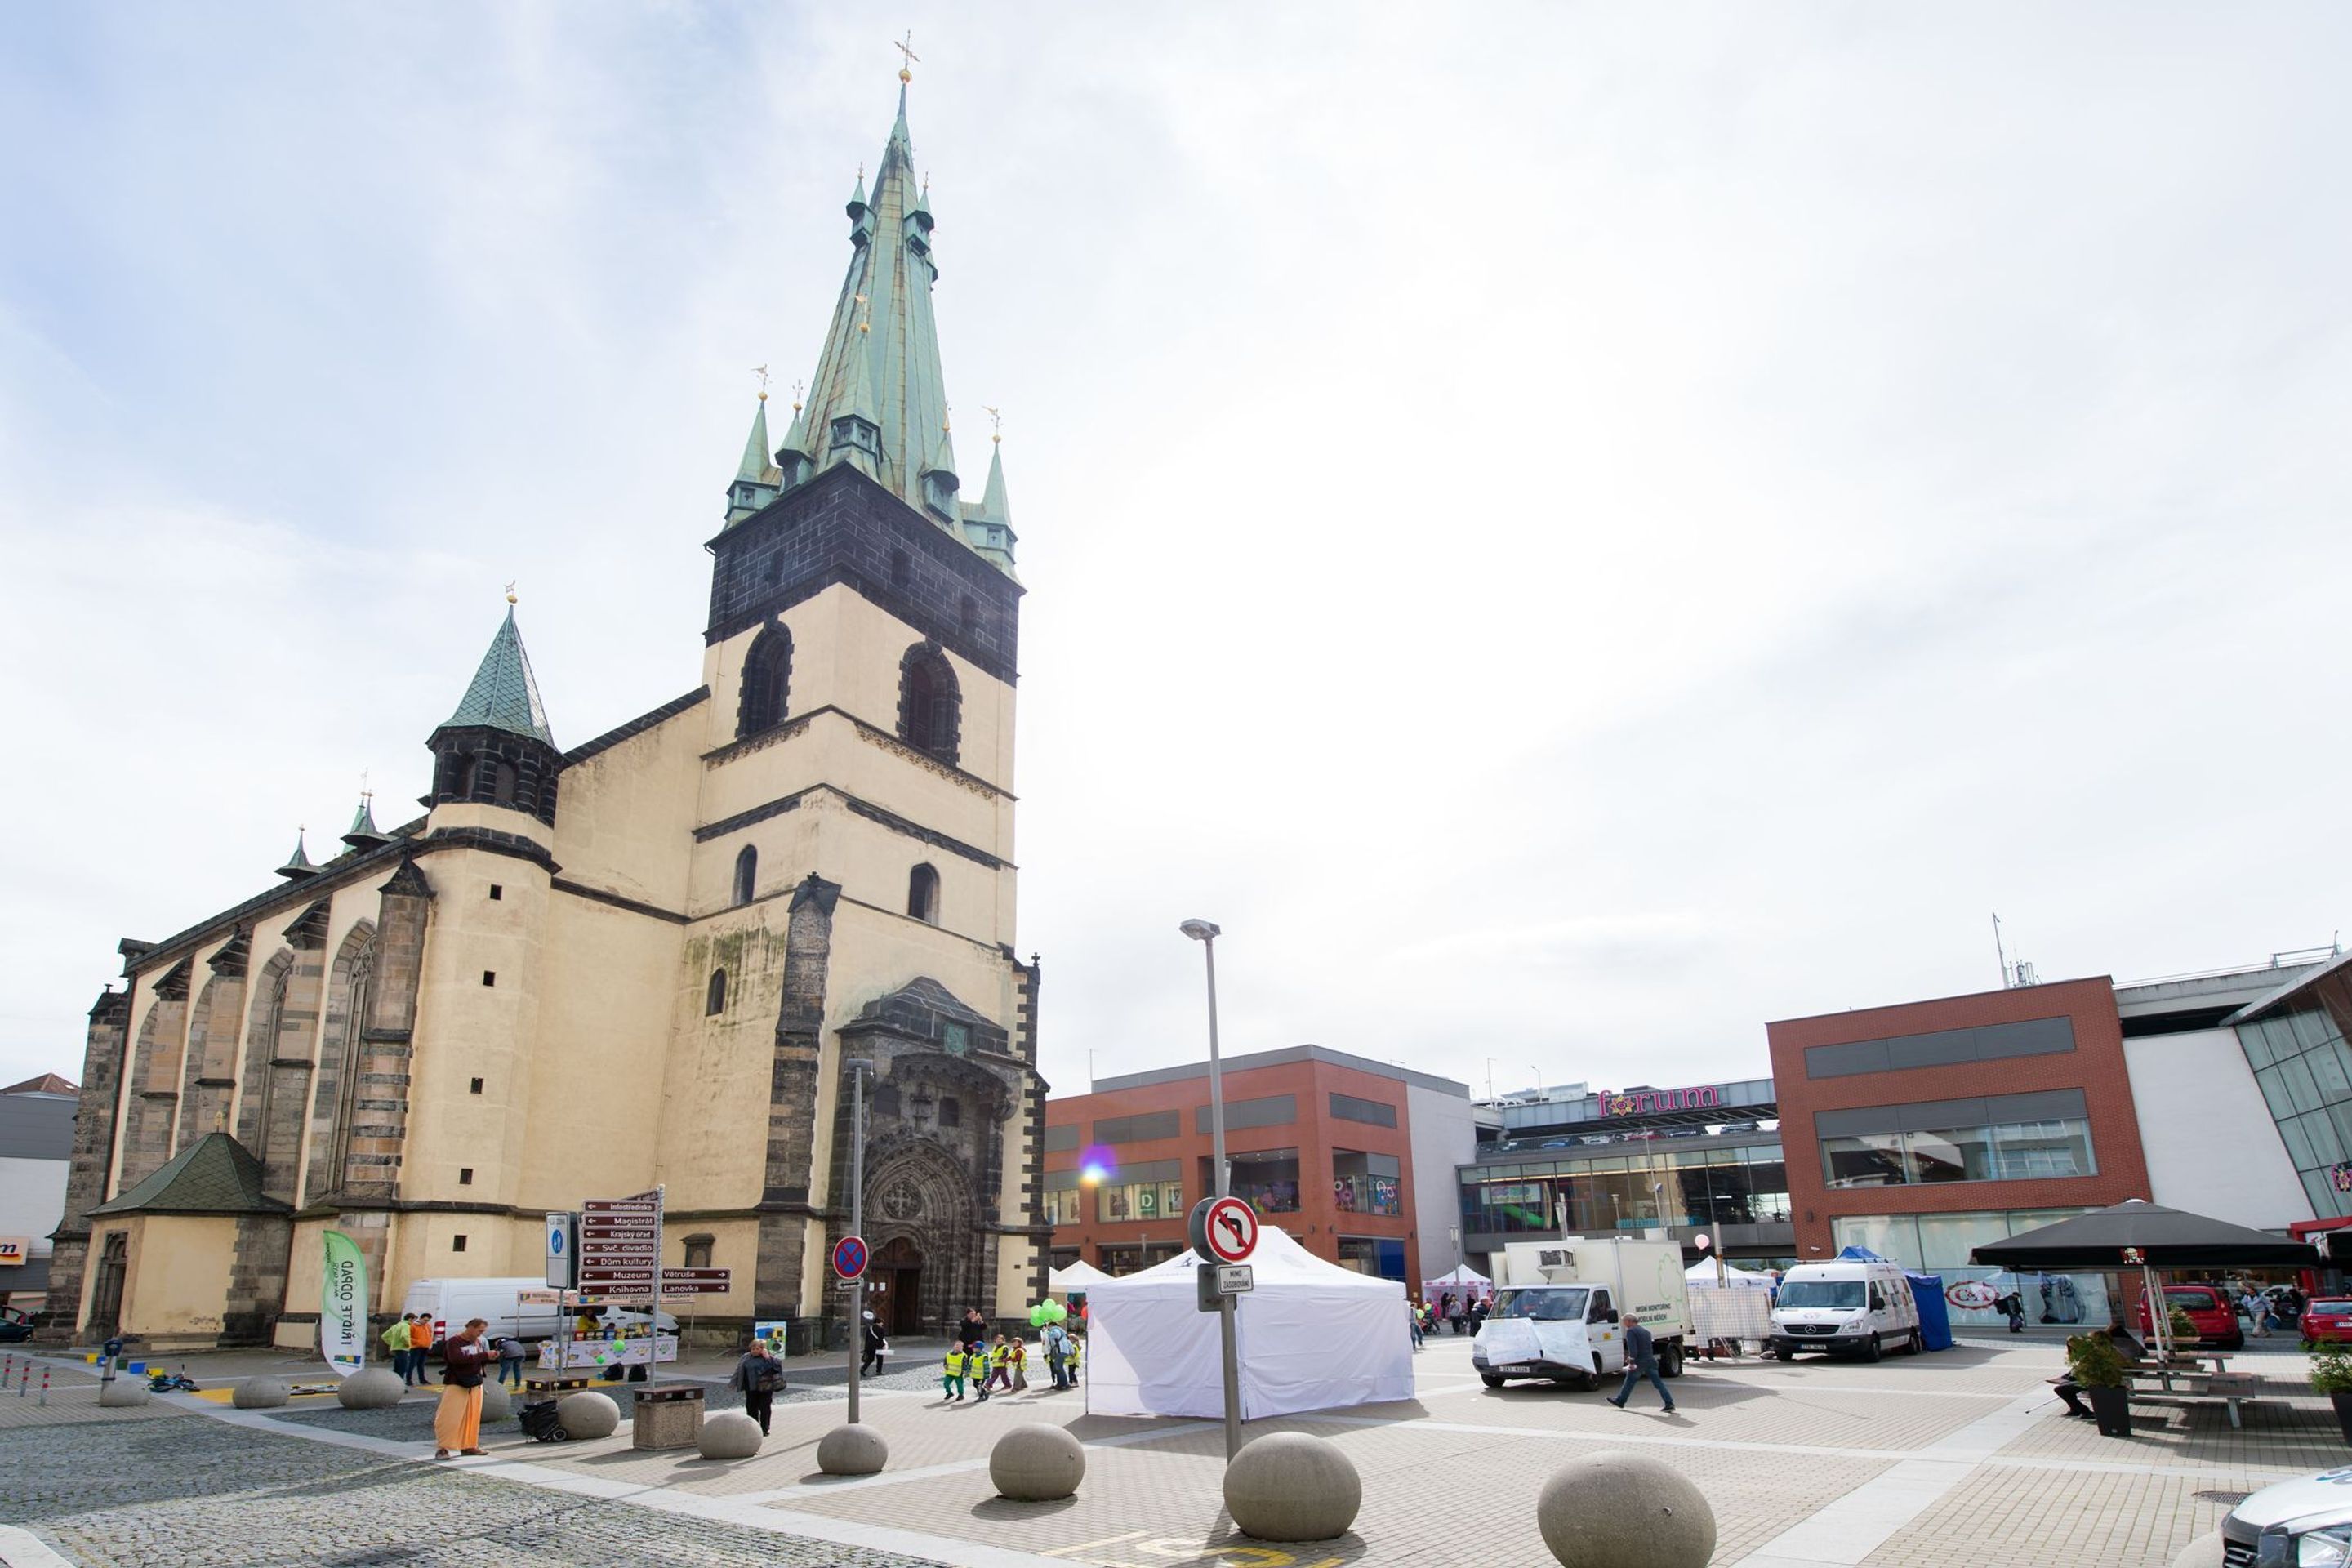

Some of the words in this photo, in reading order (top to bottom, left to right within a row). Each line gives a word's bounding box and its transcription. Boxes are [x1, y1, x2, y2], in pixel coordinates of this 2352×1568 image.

[1598, 1085, 1721, 1117] forum
[1141, 1194, 1153, 1207] D
[613, 1217, 653, 1226] Magistrát
[610, 1229, 635, 1239] Krajský
[636, 1229, 651, 1237] úřad
[600, 1258, 621, 1266] Dům
[622, 1258, 652, 1267] kultury
[664, 1270, 697, 1278] Větruše
[609, 1285, 650, 1294] Knihovna
